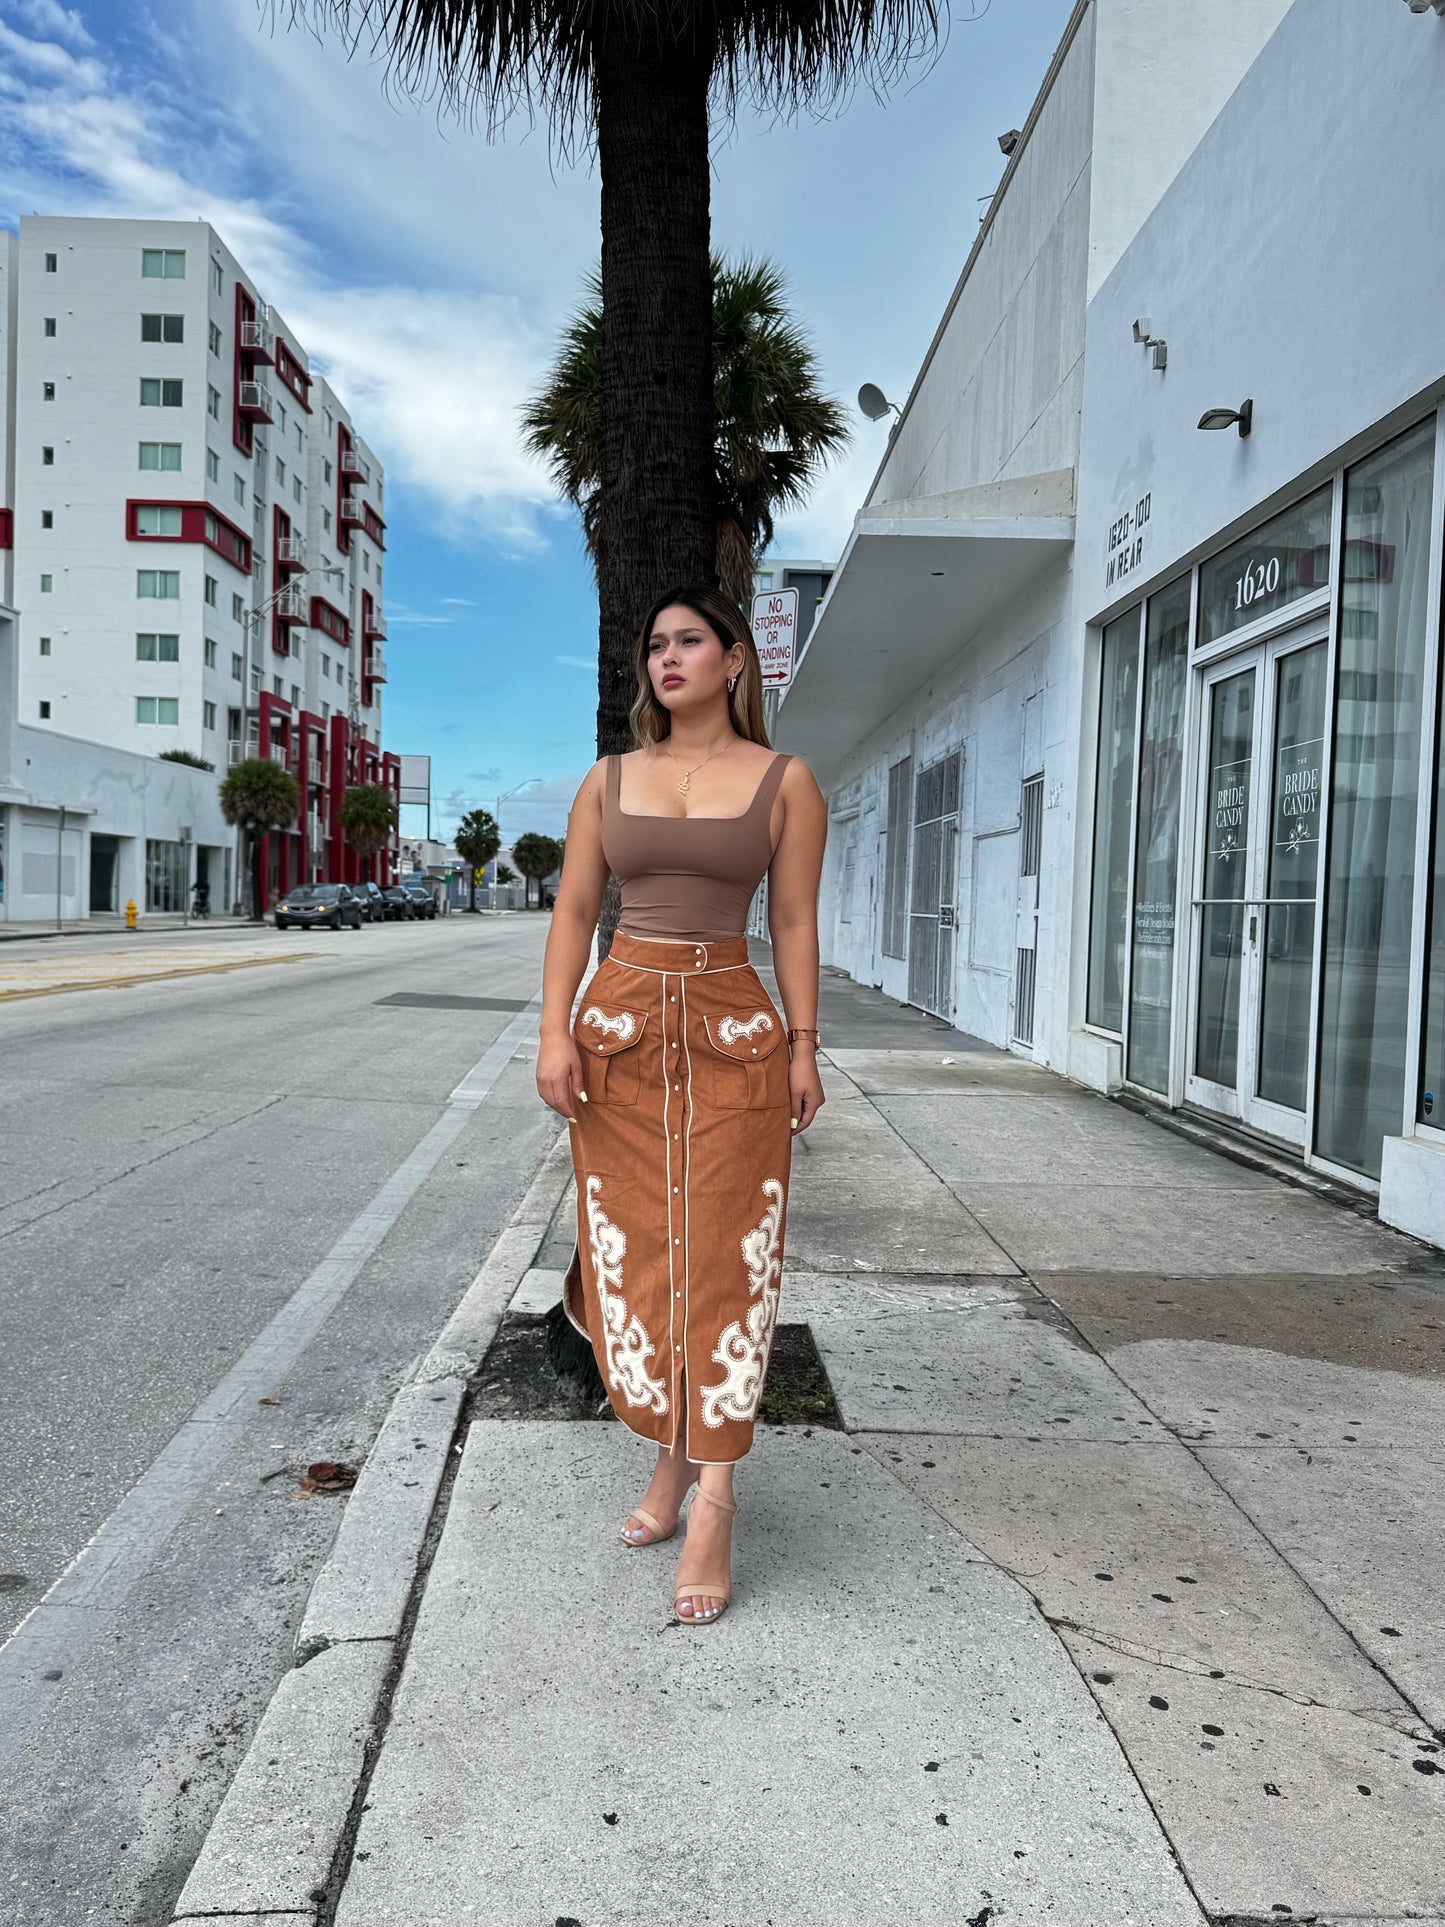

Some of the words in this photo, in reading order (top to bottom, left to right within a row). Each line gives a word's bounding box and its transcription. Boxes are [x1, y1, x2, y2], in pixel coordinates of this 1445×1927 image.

[1108, 492, 1151, 553] 1620-100
[1106, 558, 1116, 589] IN
[1117, 536, 1143, 580] REAR
[1235, 557, 1280, 610] 1620
[768, 597, 783, 614] NO
[755, 613, 793, 630] STOPPING
[766, 631, 778, 644] OR
[758, 646, 791, 660] TANDING
[1285, 768, 1318, 794] BRIDE
[1218, 786, 1244, 808] BRIDE
[1283, 791, 1318, 816] CANDY
[1216, 807, 1244, 828] CANDY
